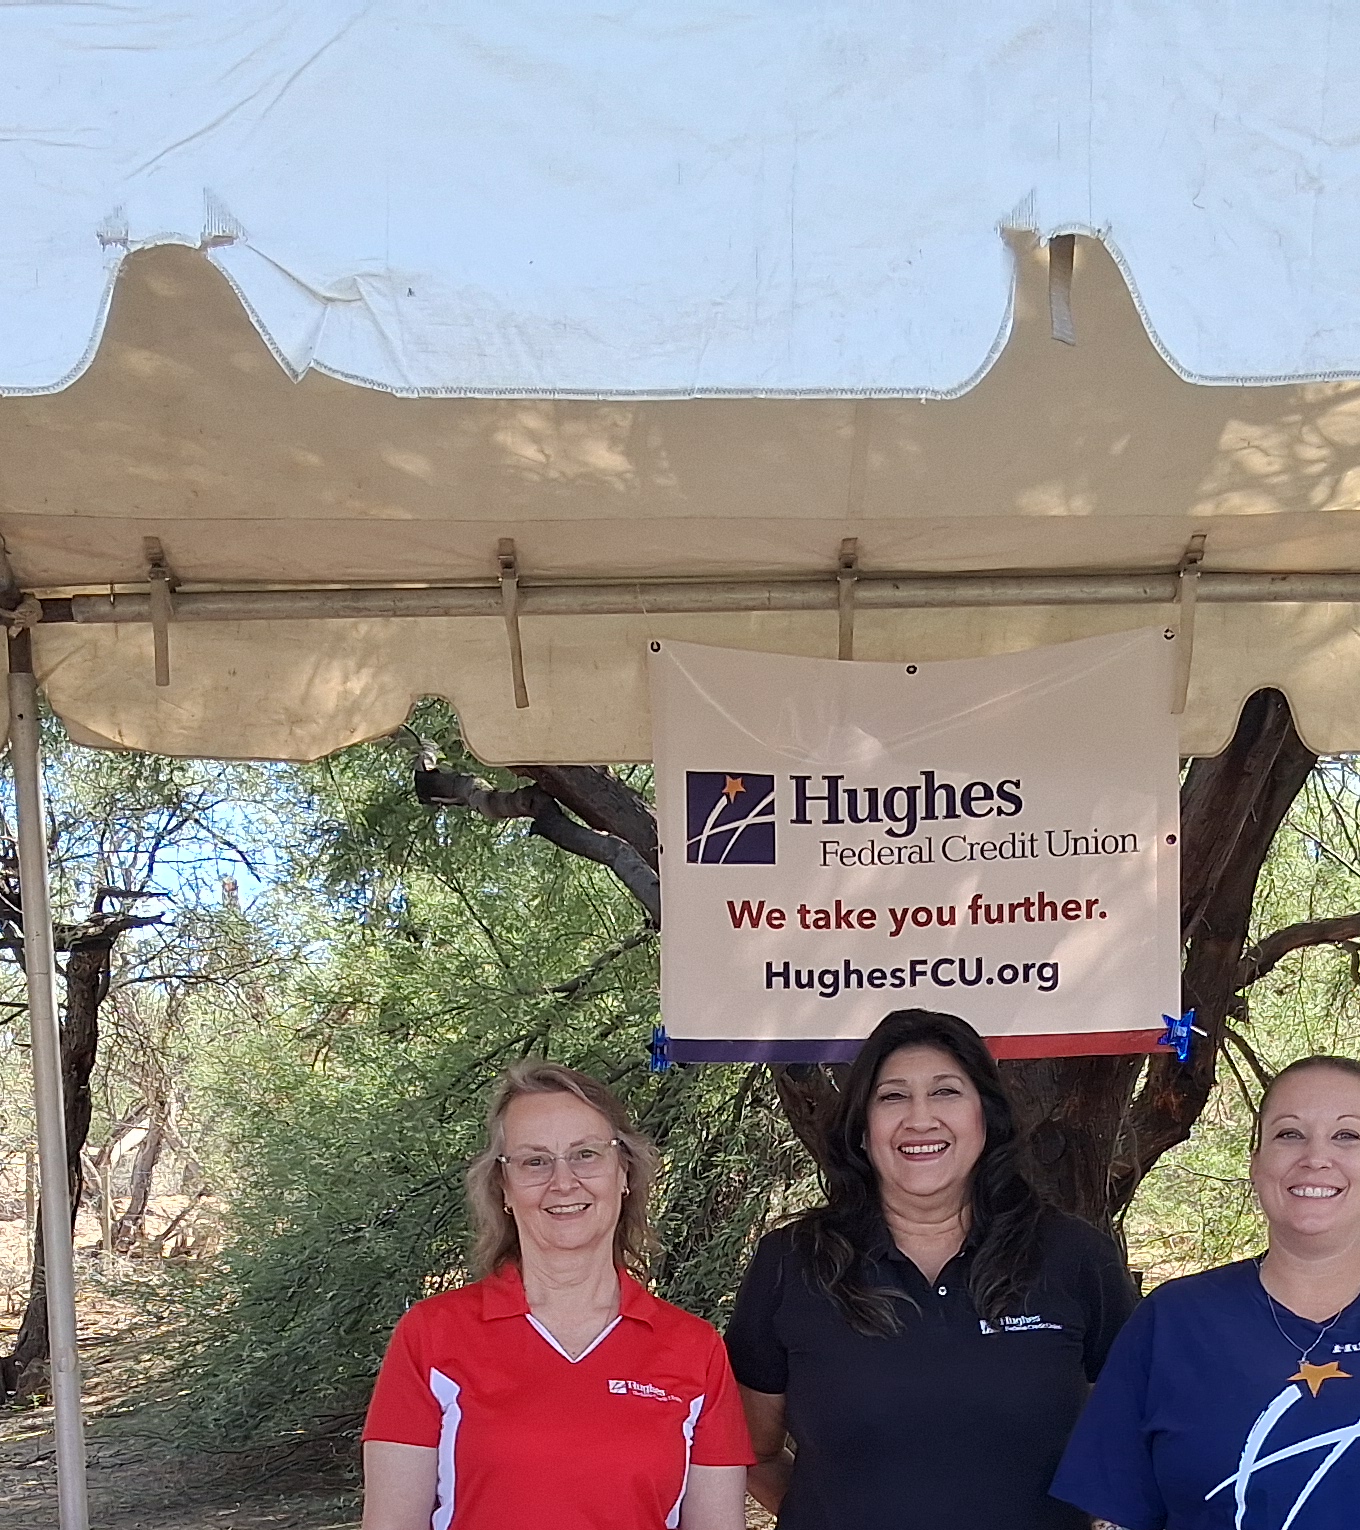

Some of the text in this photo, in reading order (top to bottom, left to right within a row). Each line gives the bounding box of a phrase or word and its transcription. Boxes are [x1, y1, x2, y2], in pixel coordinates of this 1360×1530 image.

[790, 771, 1023, 838] Hughes
[820, 829, 1139, 867] Federal Credit Union
[727, 892, 1108, 937] We take you further.
[765, 957, 1059, 997] HughesFCU.org
